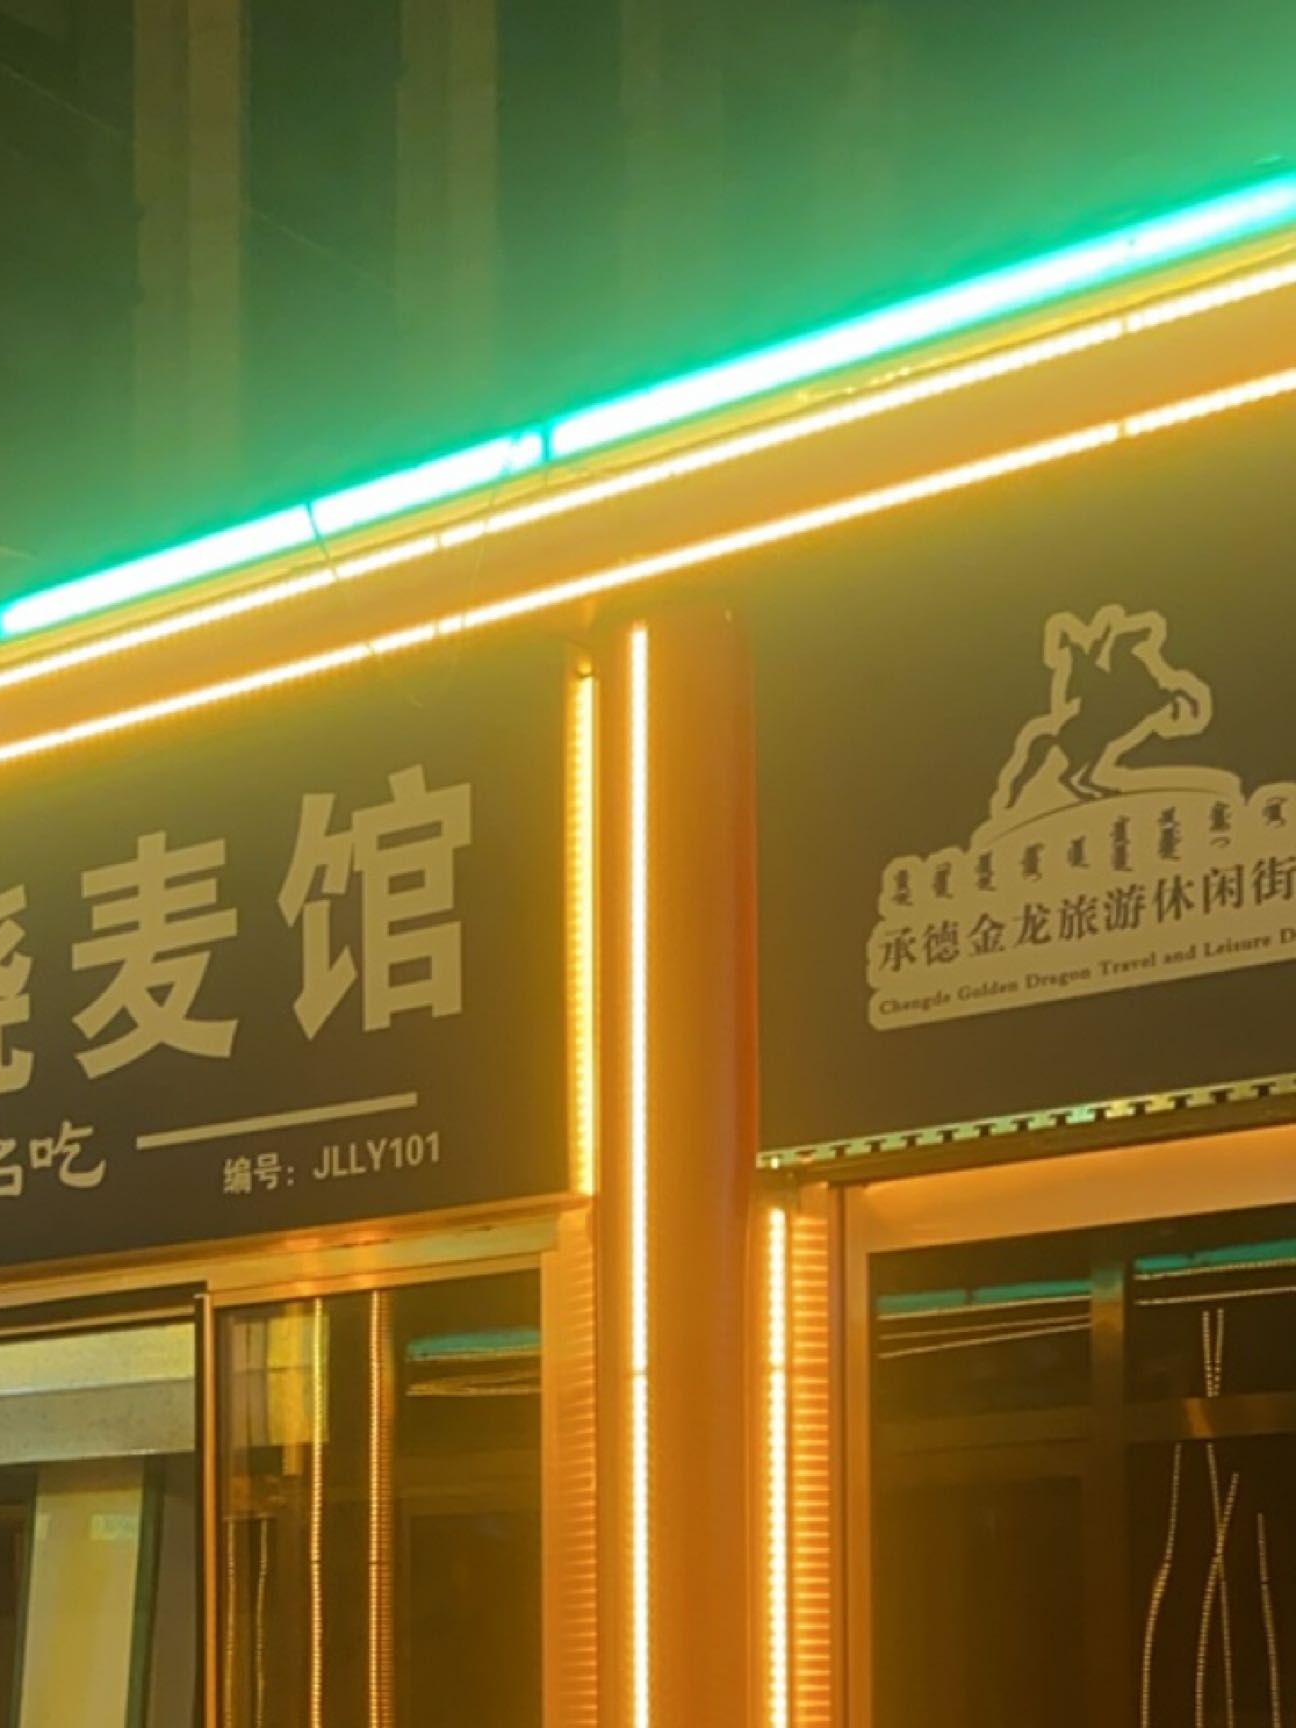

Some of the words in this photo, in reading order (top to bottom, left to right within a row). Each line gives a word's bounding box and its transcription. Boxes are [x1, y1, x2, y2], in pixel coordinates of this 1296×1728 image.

[879, 856, 1296, 972] 承德金龙旅游休闲街
[879, 989, 951, 1016] Chengde
[958, 978, 1018, 1001] Golden
[1026, 966, 1091, 989] Dragon
[1099, 953, 1157, 976] Travel
[1164, 944, 1196, 966] and
[1203, 934, 1271, 958] Leisure
